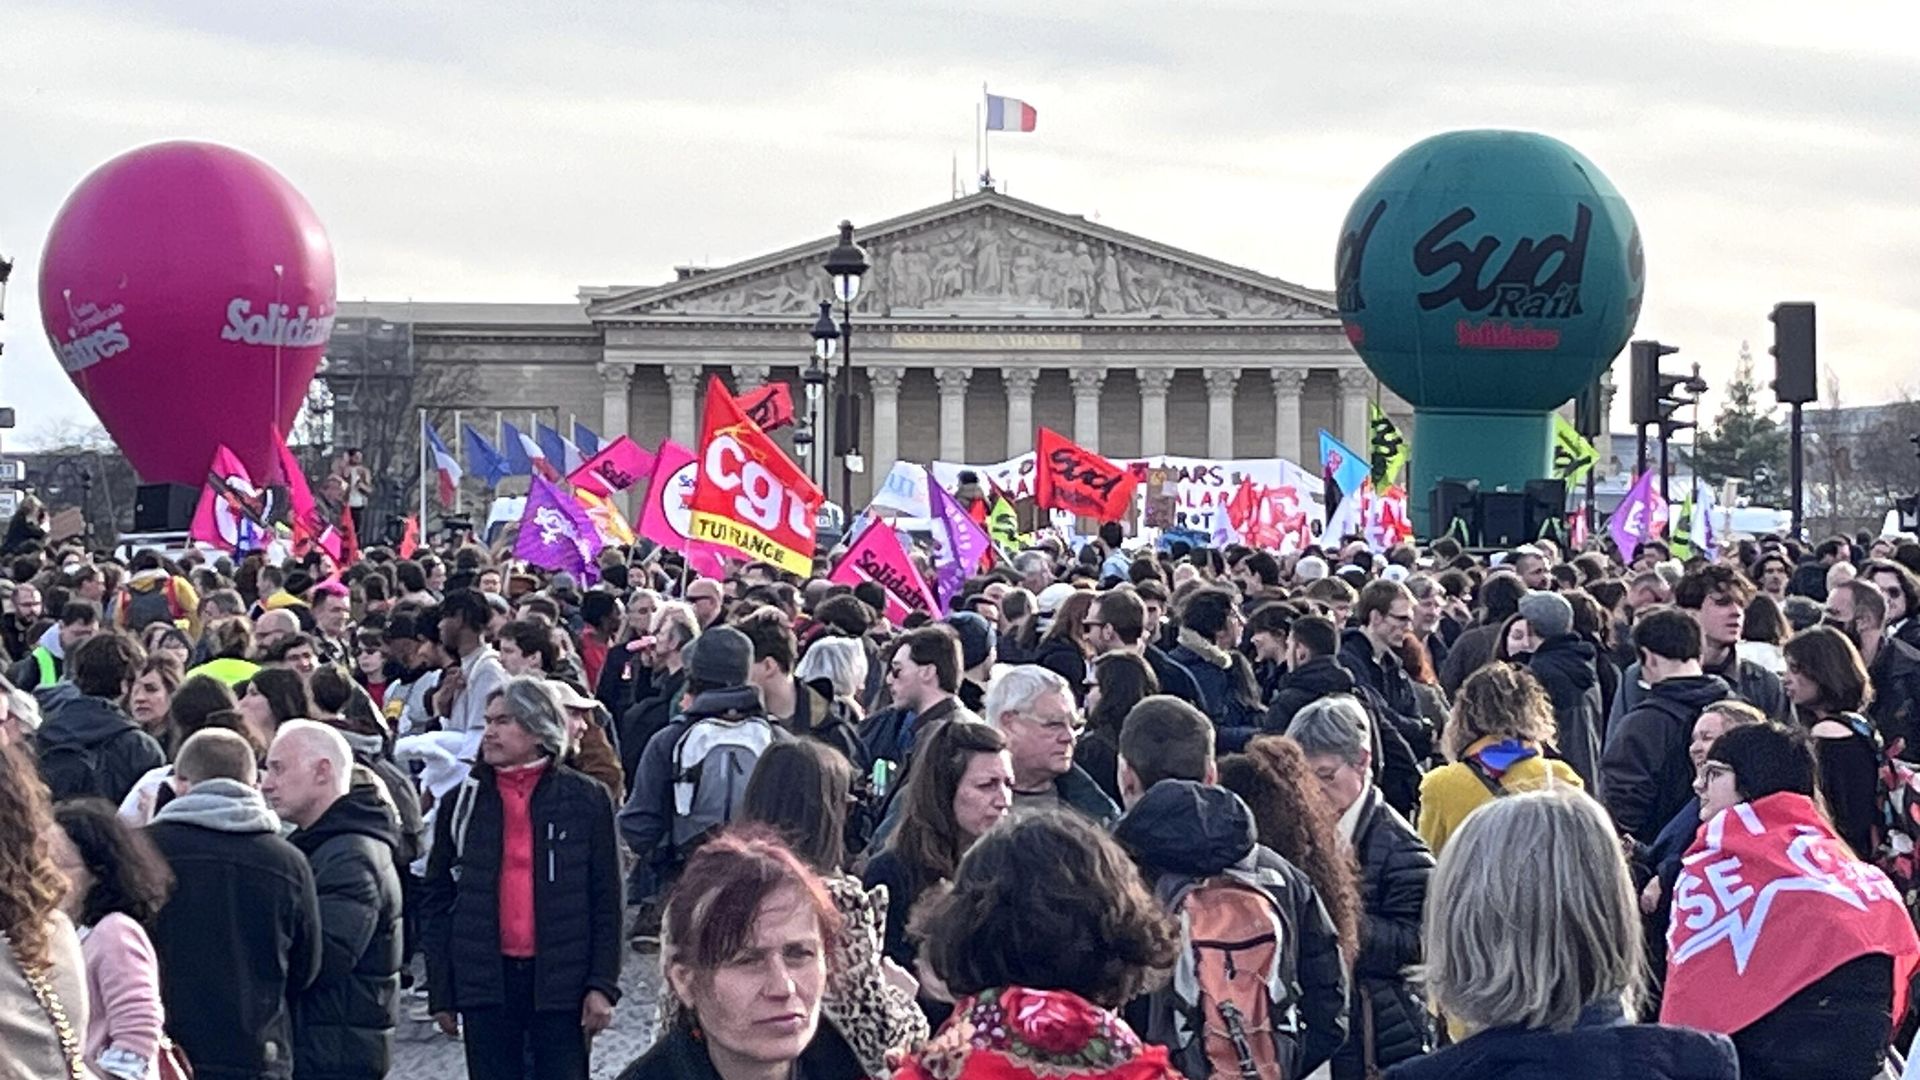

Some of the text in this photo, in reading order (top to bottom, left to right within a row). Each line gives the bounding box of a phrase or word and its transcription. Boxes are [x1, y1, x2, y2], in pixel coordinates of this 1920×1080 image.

[1413, 202, 1592, 313] Sud
[1488, 283, 1584, 318] Rail
[1051, 448, 1122, 502] Sud
[1163, 465, 1224, 487] ARS
